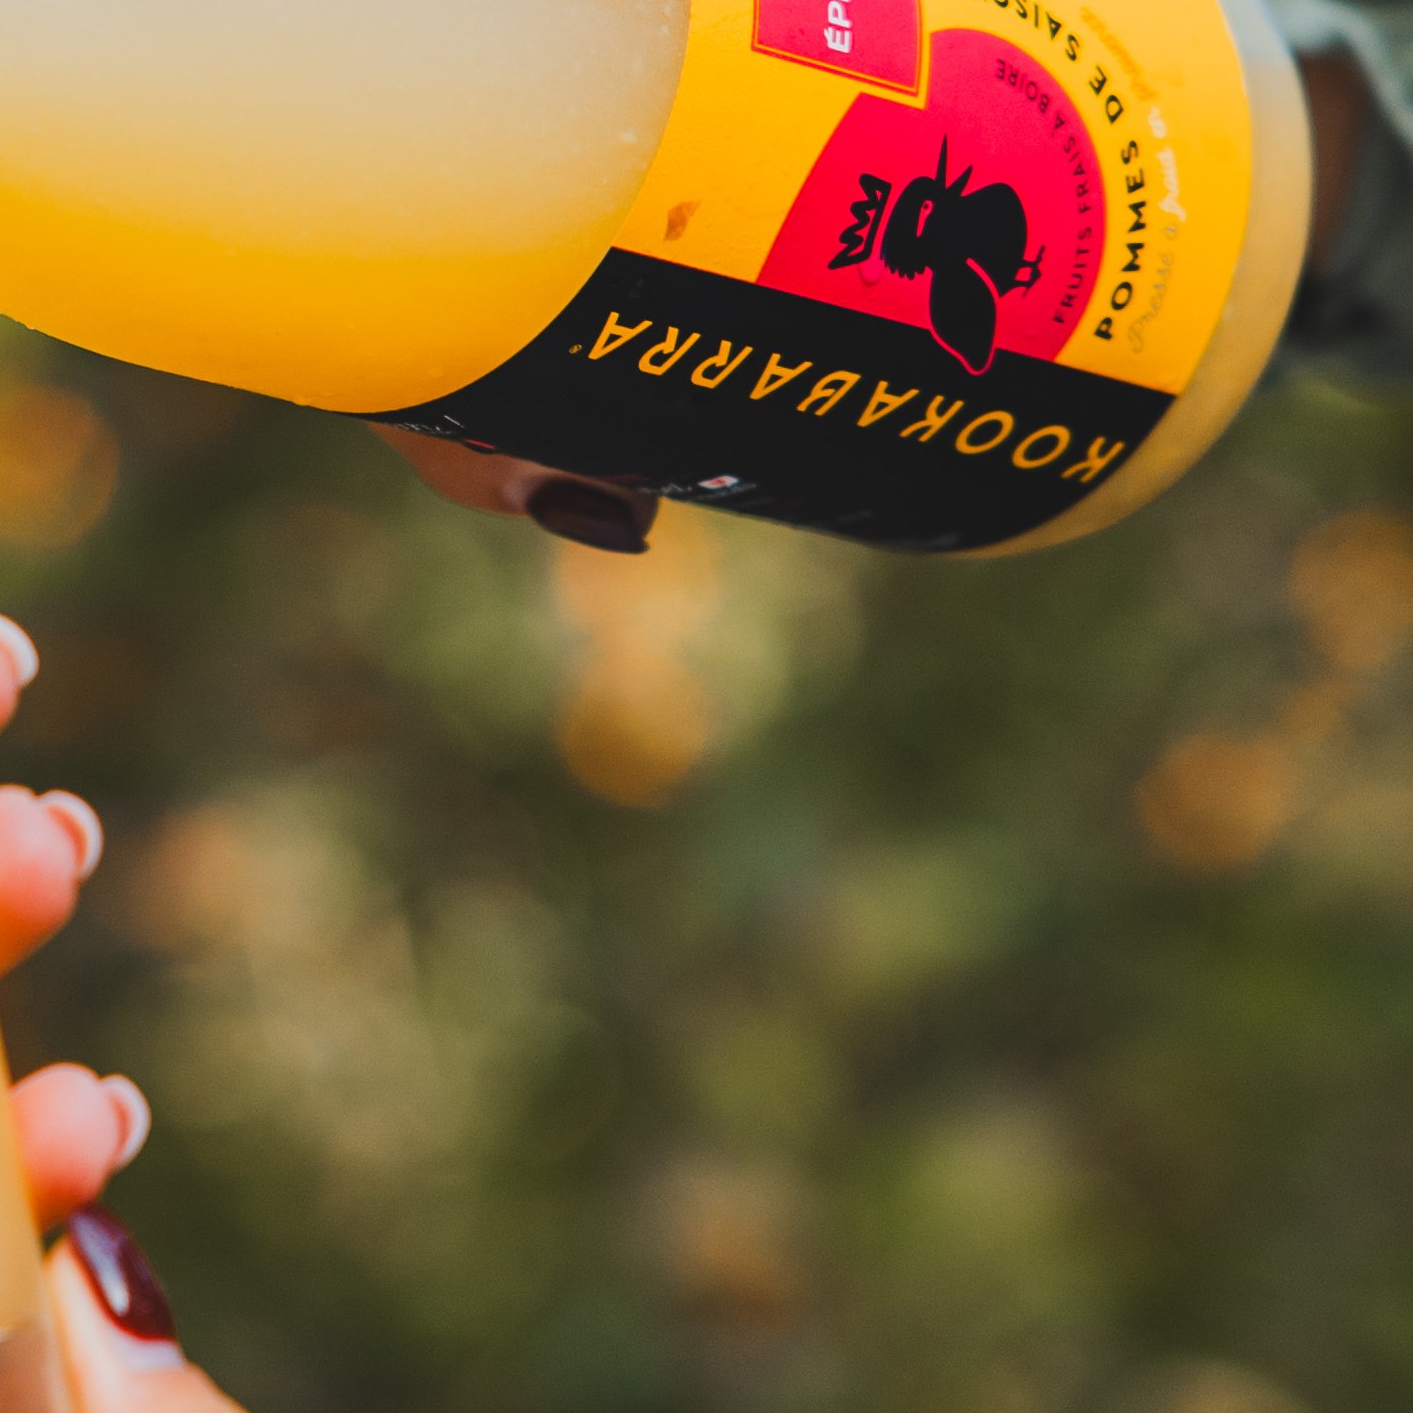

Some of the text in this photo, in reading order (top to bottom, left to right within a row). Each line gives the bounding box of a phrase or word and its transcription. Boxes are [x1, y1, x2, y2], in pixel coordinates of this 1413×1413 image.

[995, 57, 1050, 115] BOIRE
[1088, 65, 1124, 124] DE
[1063, 136, 1092, 215] FRAIS
[1053, 226, 1092, 324] FRUITS
[1094, 140, 1147, 341] POMMES
[588, 312, 1125, 483] KOOKABARRA
